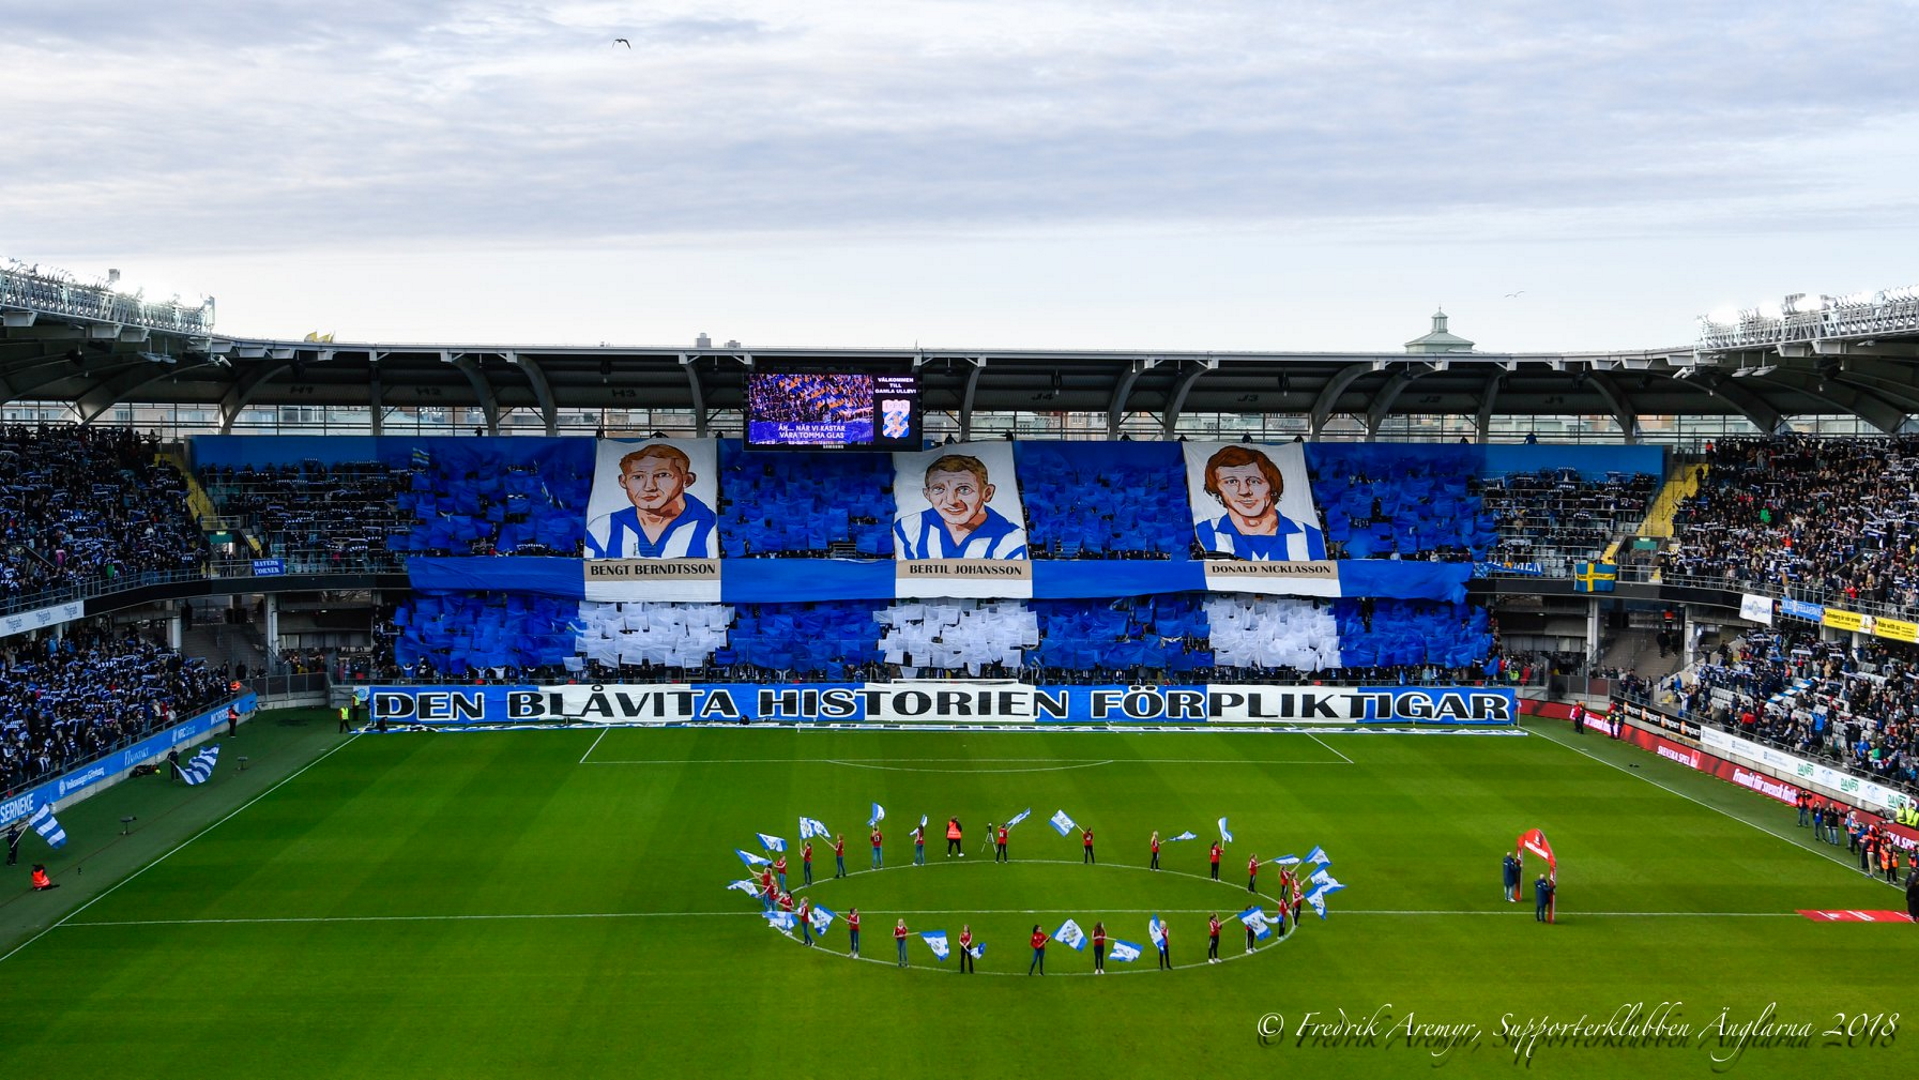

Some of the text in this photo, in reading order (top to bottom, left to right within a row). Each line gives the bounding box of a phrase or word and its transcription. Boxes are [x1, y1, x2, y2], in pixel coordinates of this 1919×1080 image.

[612, 389, 636, 397] H3
[796, 423, 810, 431] NÄR
[779, 430, 798, 438] VÅRA
[591, 564, 715, 575] BENGT BERNDTSSON
[909, 564, 1022, 575] BERTIL JOHANSSON
[1211, 565, 1331, 574] DONALD NICKLASSON
[373, 684, 1510, 722] DEN BLÅVITA HISTORIEN FÖRPLIKTIGAR
[1841, 777, 1859, 792] DANFO
[0, 793, 34, 824] SERNEKE
